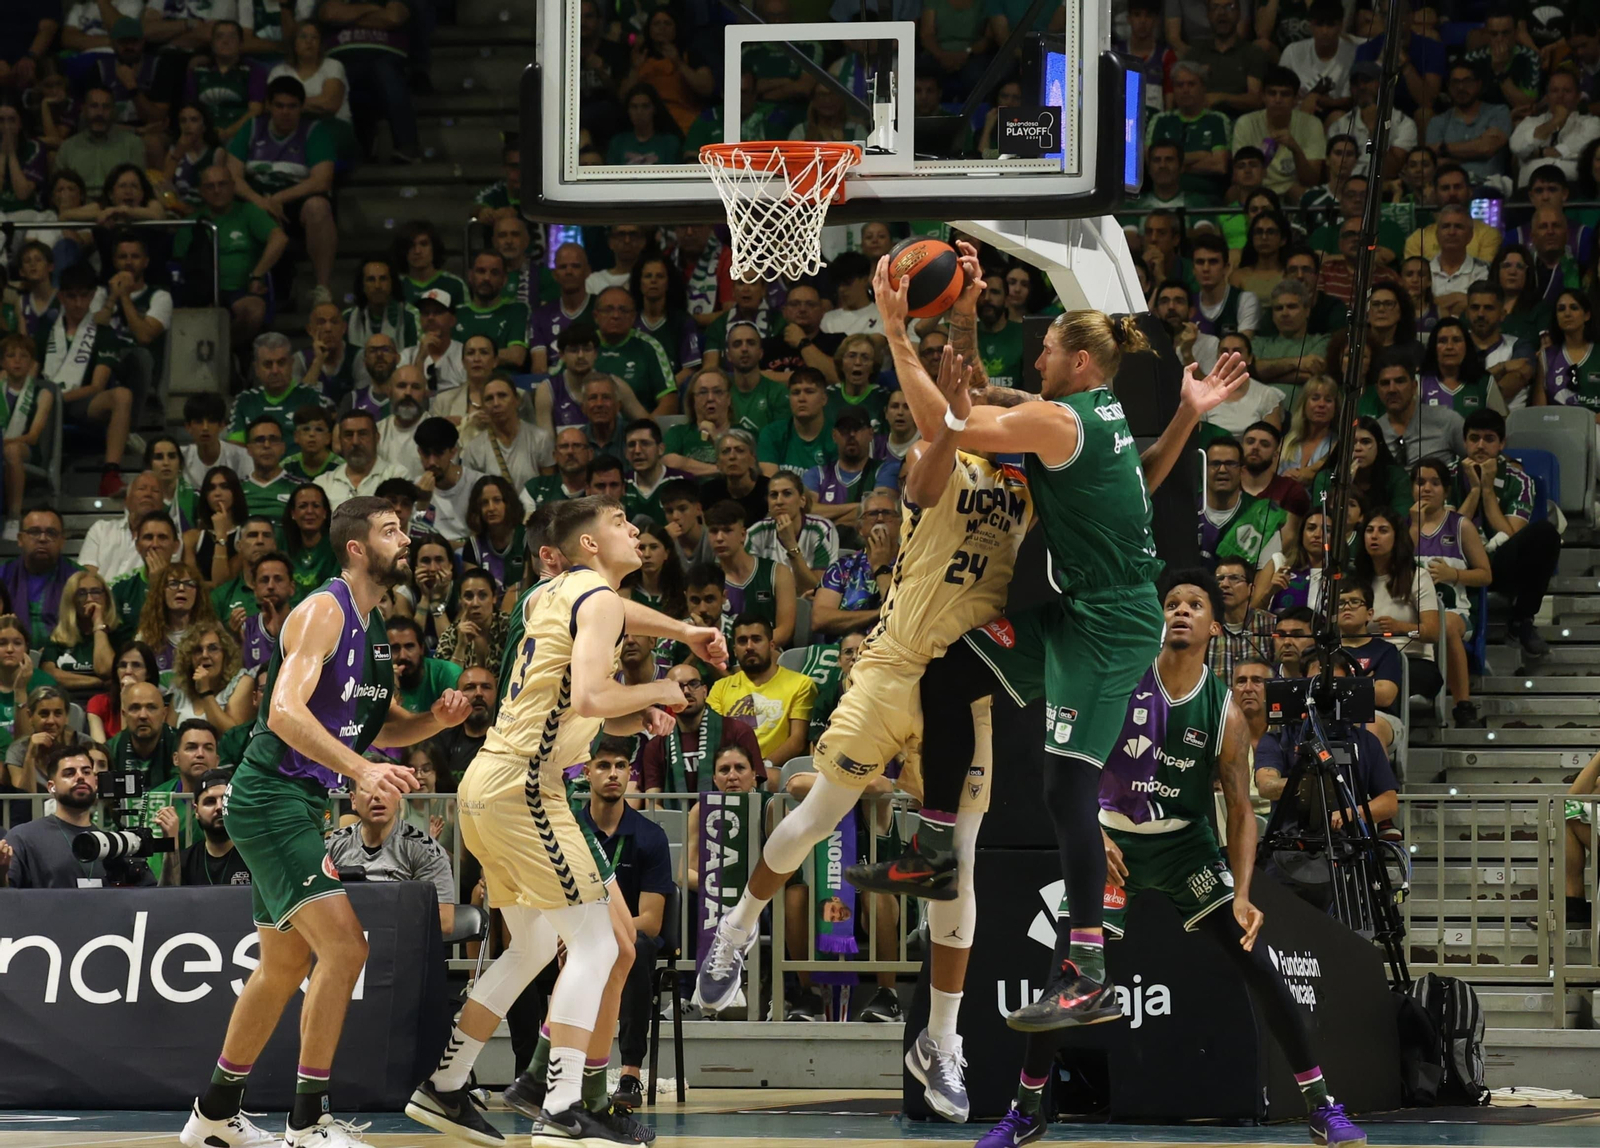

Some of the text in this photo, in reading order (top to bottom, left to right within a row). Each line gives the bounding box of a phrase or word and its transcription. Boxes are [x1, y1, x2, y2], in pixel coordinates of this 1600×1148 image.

[1006, 127, 1047, 136] PLAYOFF
[956, 488, 1026, 526] UCAM
[944, 549, 988, 585] 24
[353, 683, 388, 702] Unicaja
[1572, 754, 1579, 764] 5
[1496, 872, 1504, 881] 3
[1455, 932, 1463, 942] 2
[1279, 950, 1321, 978] Fundación
